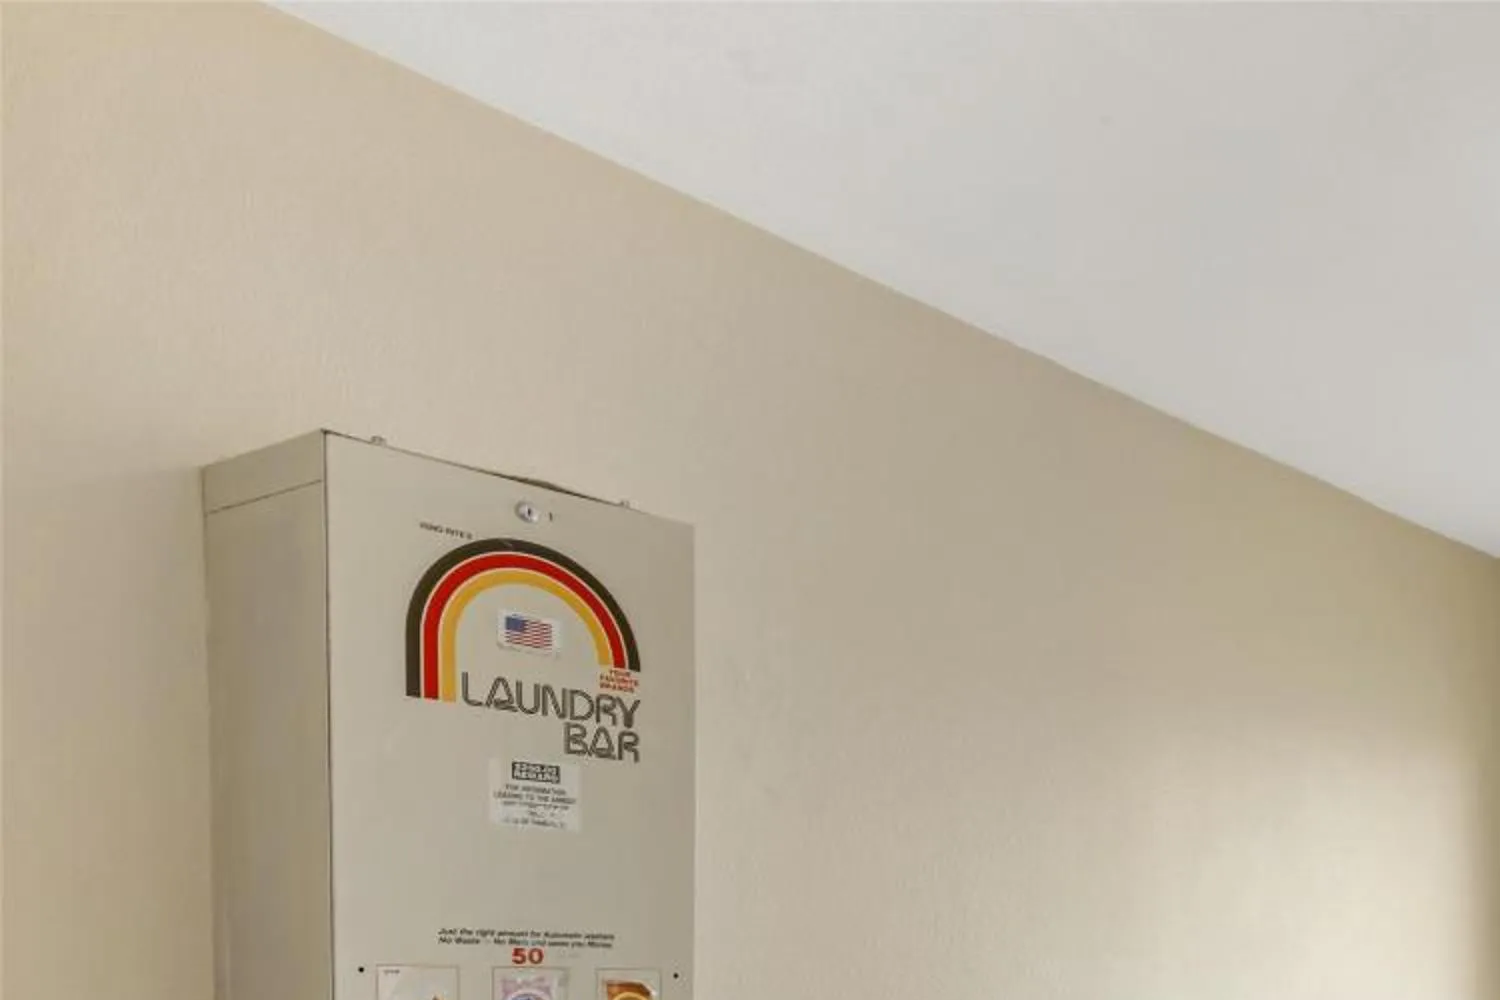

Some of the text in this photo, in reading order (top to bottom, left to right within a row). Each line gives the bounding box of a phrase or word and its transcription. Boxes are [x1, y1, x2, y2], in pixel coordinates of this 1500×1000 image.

[461, 671, 641, 728] LAUNDRY
[563, 721, 640, 763] BAR
[511, 947, 544, 965] 50
